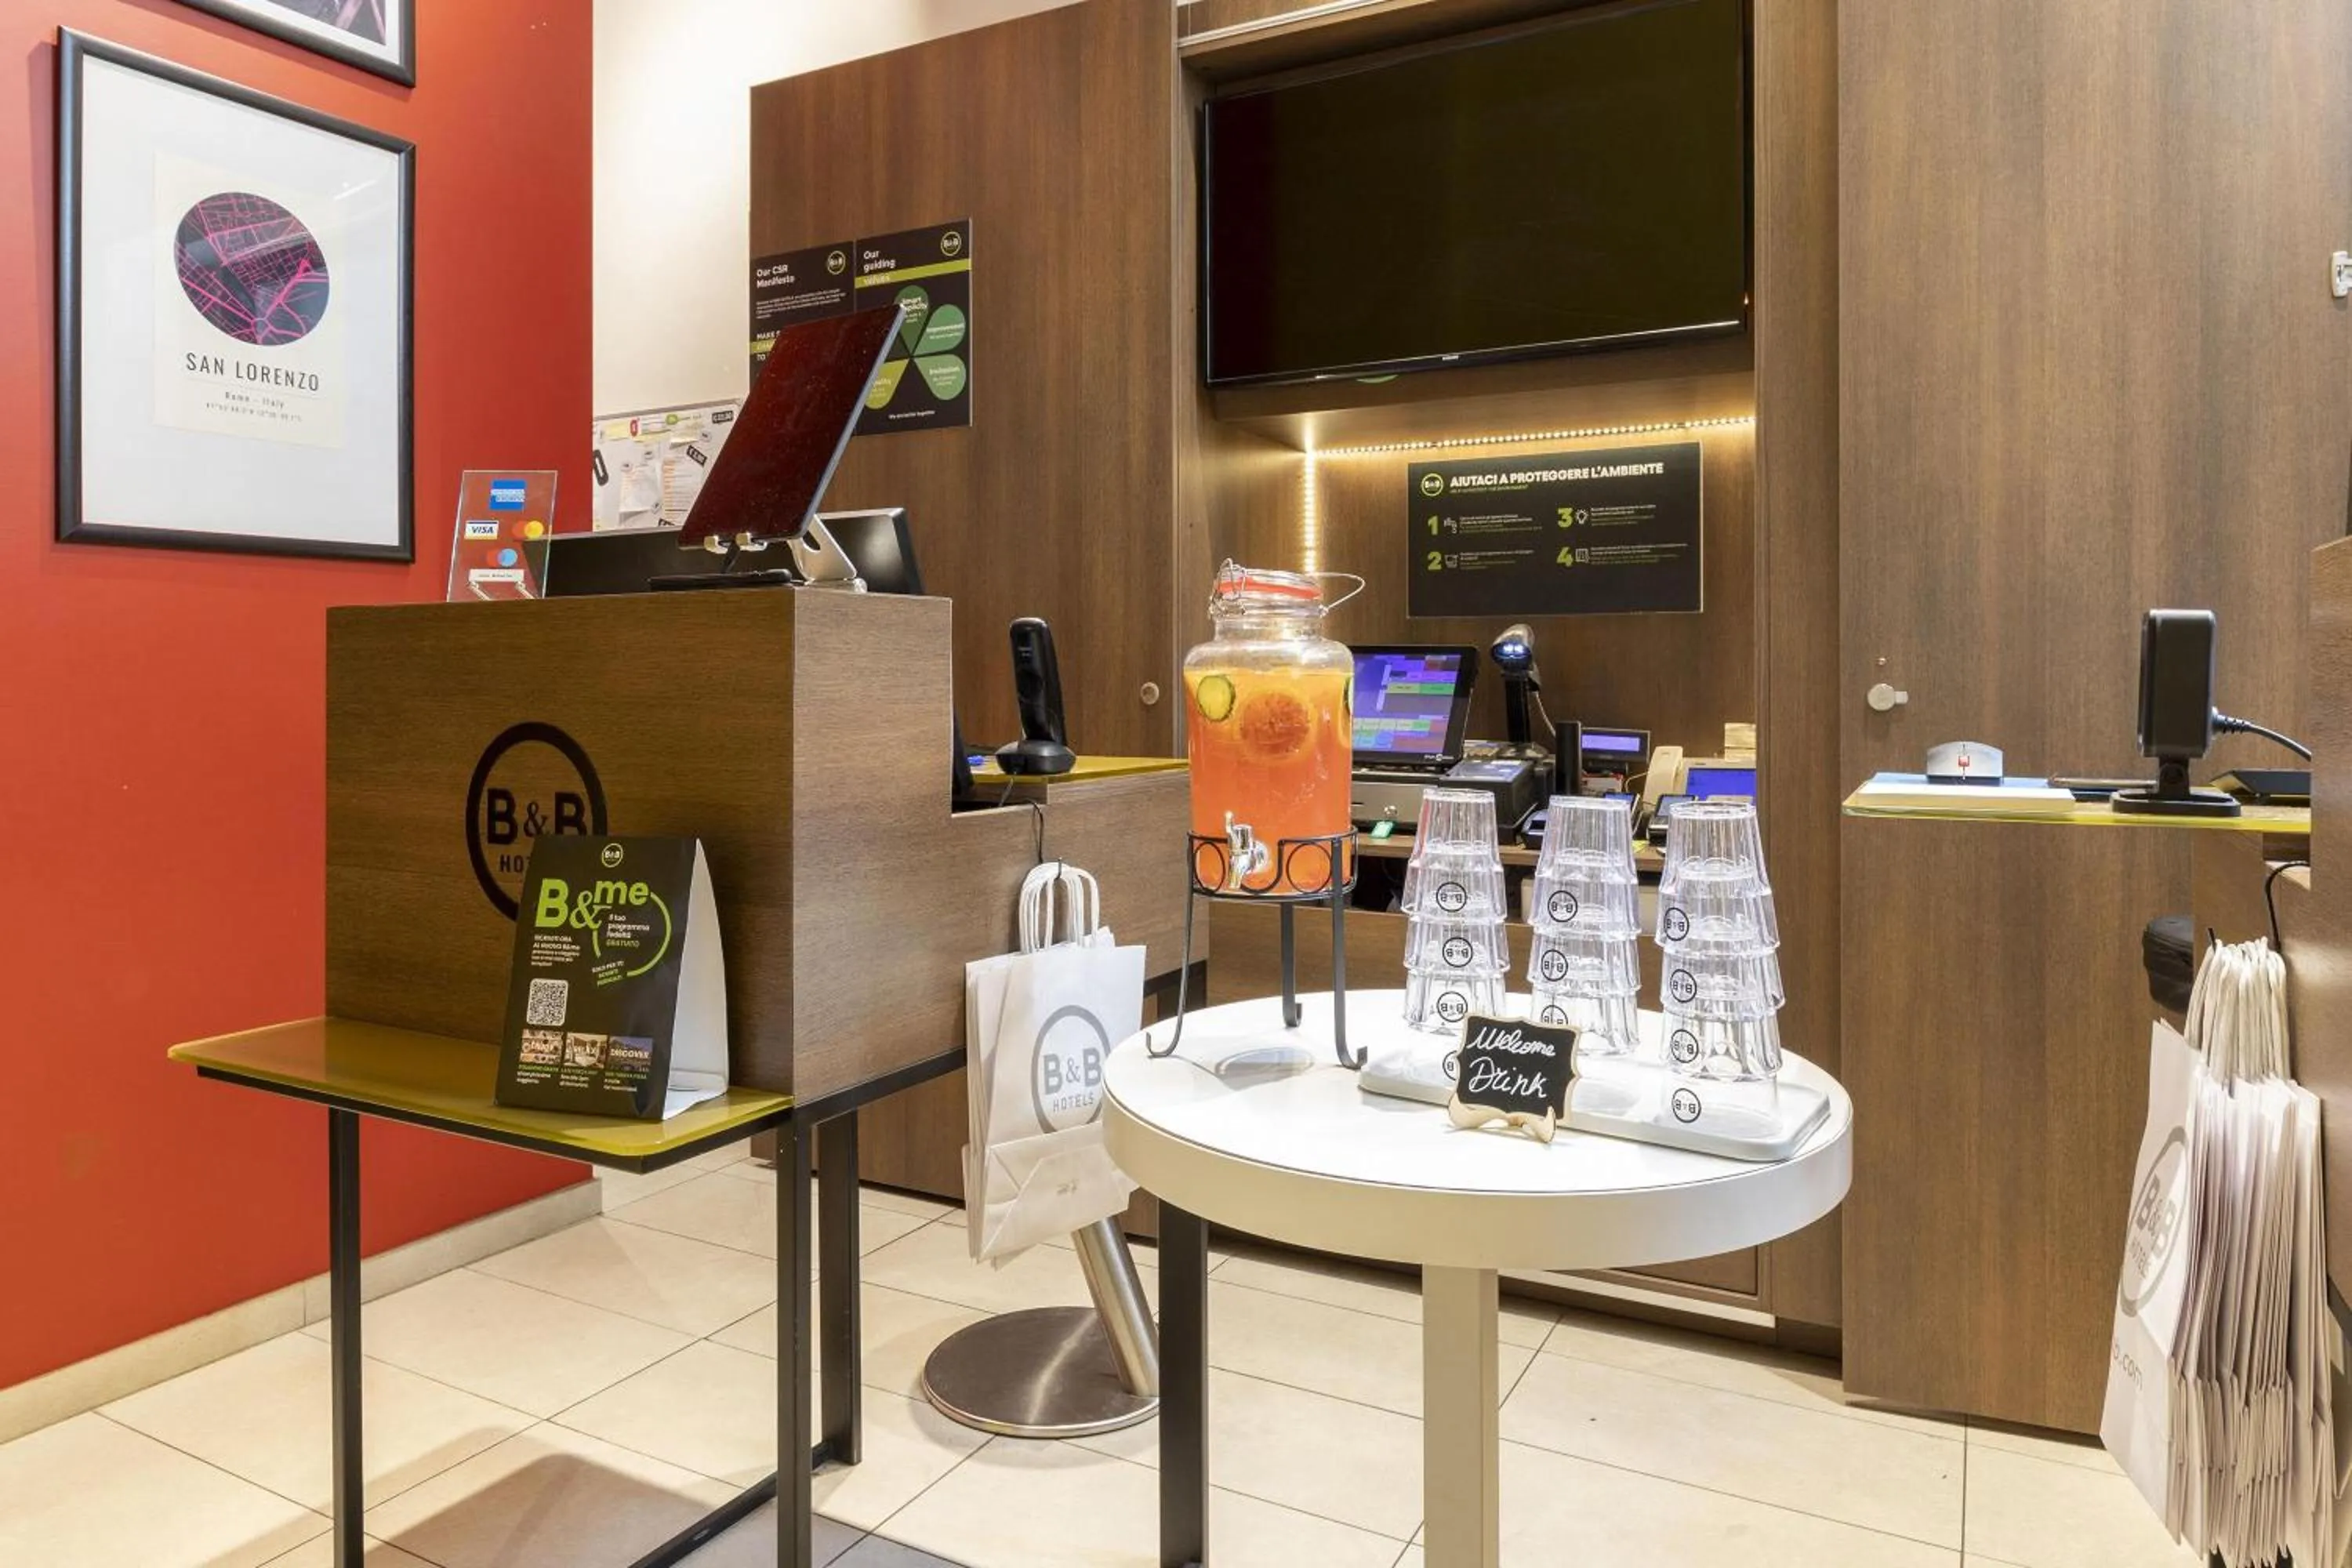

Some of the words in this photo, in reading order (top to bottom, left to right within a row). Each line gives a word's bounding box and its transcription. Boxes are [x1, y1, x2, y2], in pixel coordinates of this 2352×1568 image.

[863, 251, 879, 260] Our
[772, 264, 788, 274] CSR
[863, 260, 895, 273] guiding
[757, 275, 795, 289] Manifesto
[186, 352, 225, 376] SAN
[235, 360, 320, 391] LORENZO
[1450, 474, 1497, 488] AIUTACI
[1499, 474, 1509, 485] A
[1510, 468, 1589, 483] PROTEGGERE
[1591, 463, 1664, 478] L'AMBIENTE
[1428, 515, 1439, 535] 1
[1558, 507, 1573, 528] 3
[1428, 551, 1442, 571] 2
[1556, 546, 1573, 567] 4
[1466, 1026, 1556, 1057] Welcome
[1044, 1047, 1102, 1095] B&B
[1468, 1056, 1547, 1098] Drink
[1053, 1091, 1094, 1112] HOTELS
